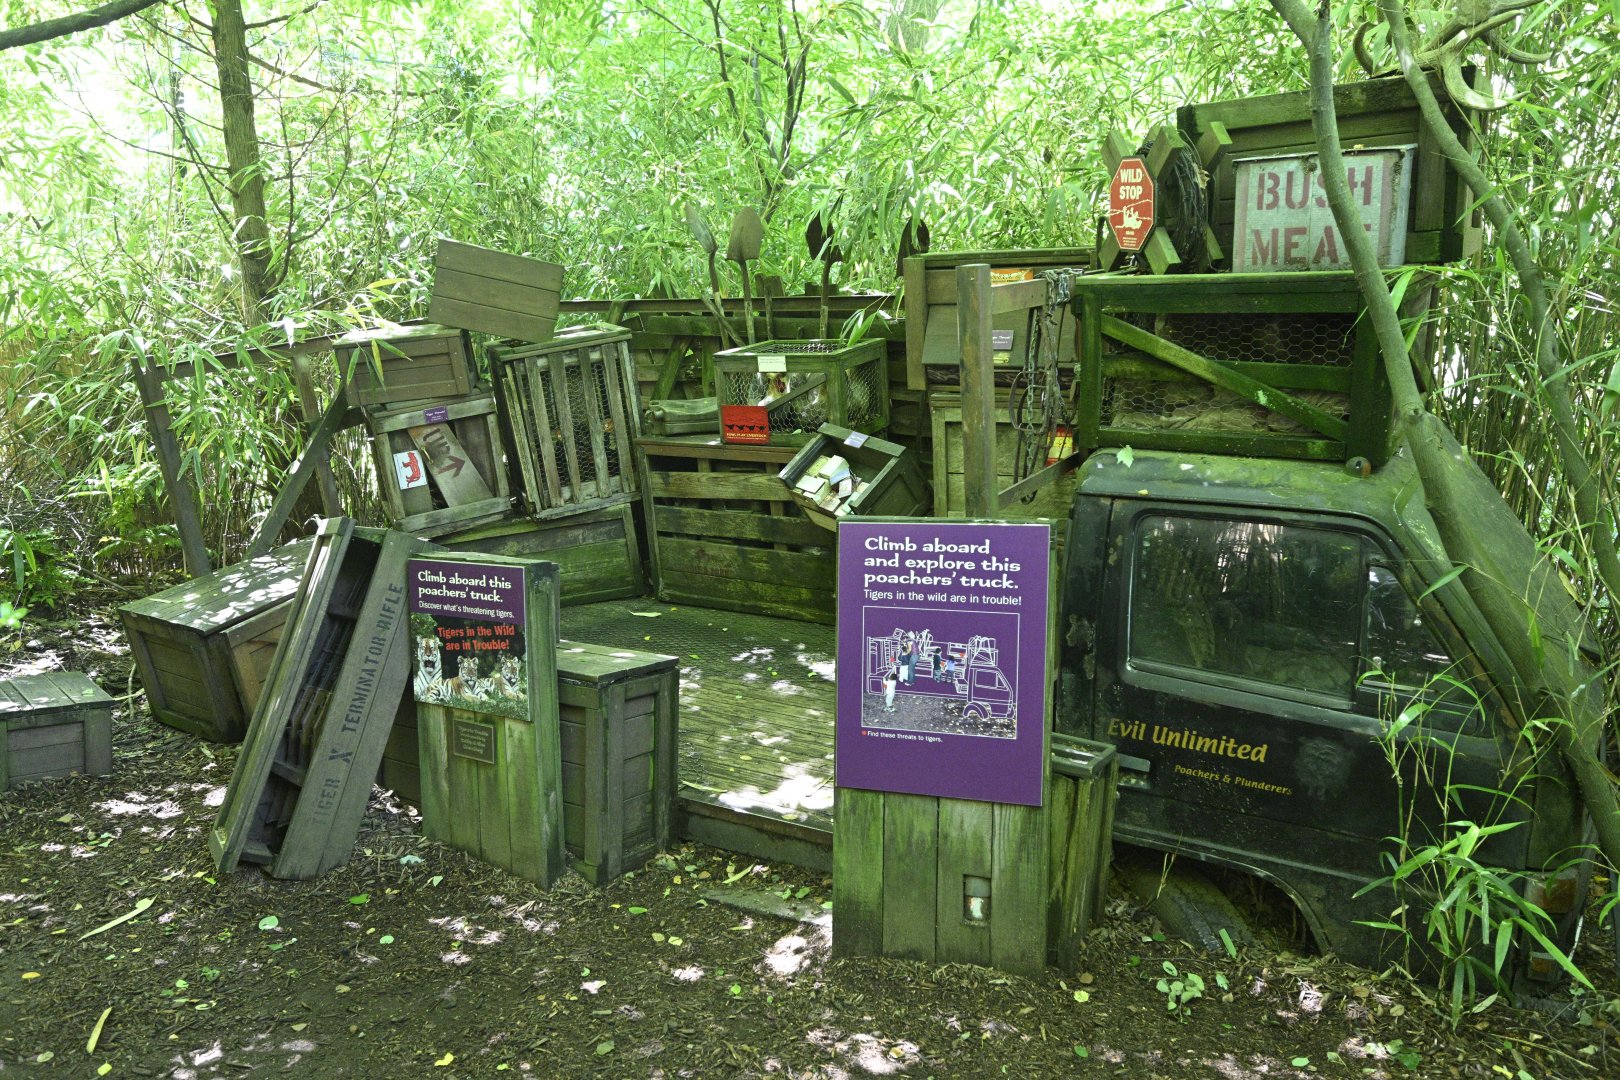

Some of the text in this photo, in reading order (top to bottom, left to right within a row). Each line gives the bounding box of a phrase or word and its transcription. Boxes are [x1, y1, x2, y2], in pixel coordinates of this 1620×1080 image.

[1120, 168, 1143, 183] WILD
[1119, 185, 1143, 200] STOP
[1251, 223, 1372, 266] MEA
[864, 535, 990, 555] Climb aboard
[864, 553, 1021, 574] and explore this
[418, 570, 512, 590] Climb aboard this
[960, 573, 1019, 589] truck.
[470, 590, 504, 603] truck.
[863, 589, 1022, 605] Tigers in the wild are in trouble!
[418, 600, 442, 610] Discover
[462, 605, 496, 617] threatening
[496, 610, 515, 619] tigers.
[437, 625, 515, 639] Tigers in the Wild
[445, 640, 510, 651] are in Trouble!
[328, 748, 353, 764] X
[341, 636, 387, 733] TERMINATOR
[376, 583, 403, 631] RIFLE
[897, 733, 917, 741] threats
[925, 735, 943, 743] tigers.
[1107, 718, 1269, 763] Evil Unlimited
[1174, 764, 1293, 796] Poachers & Plunderers
